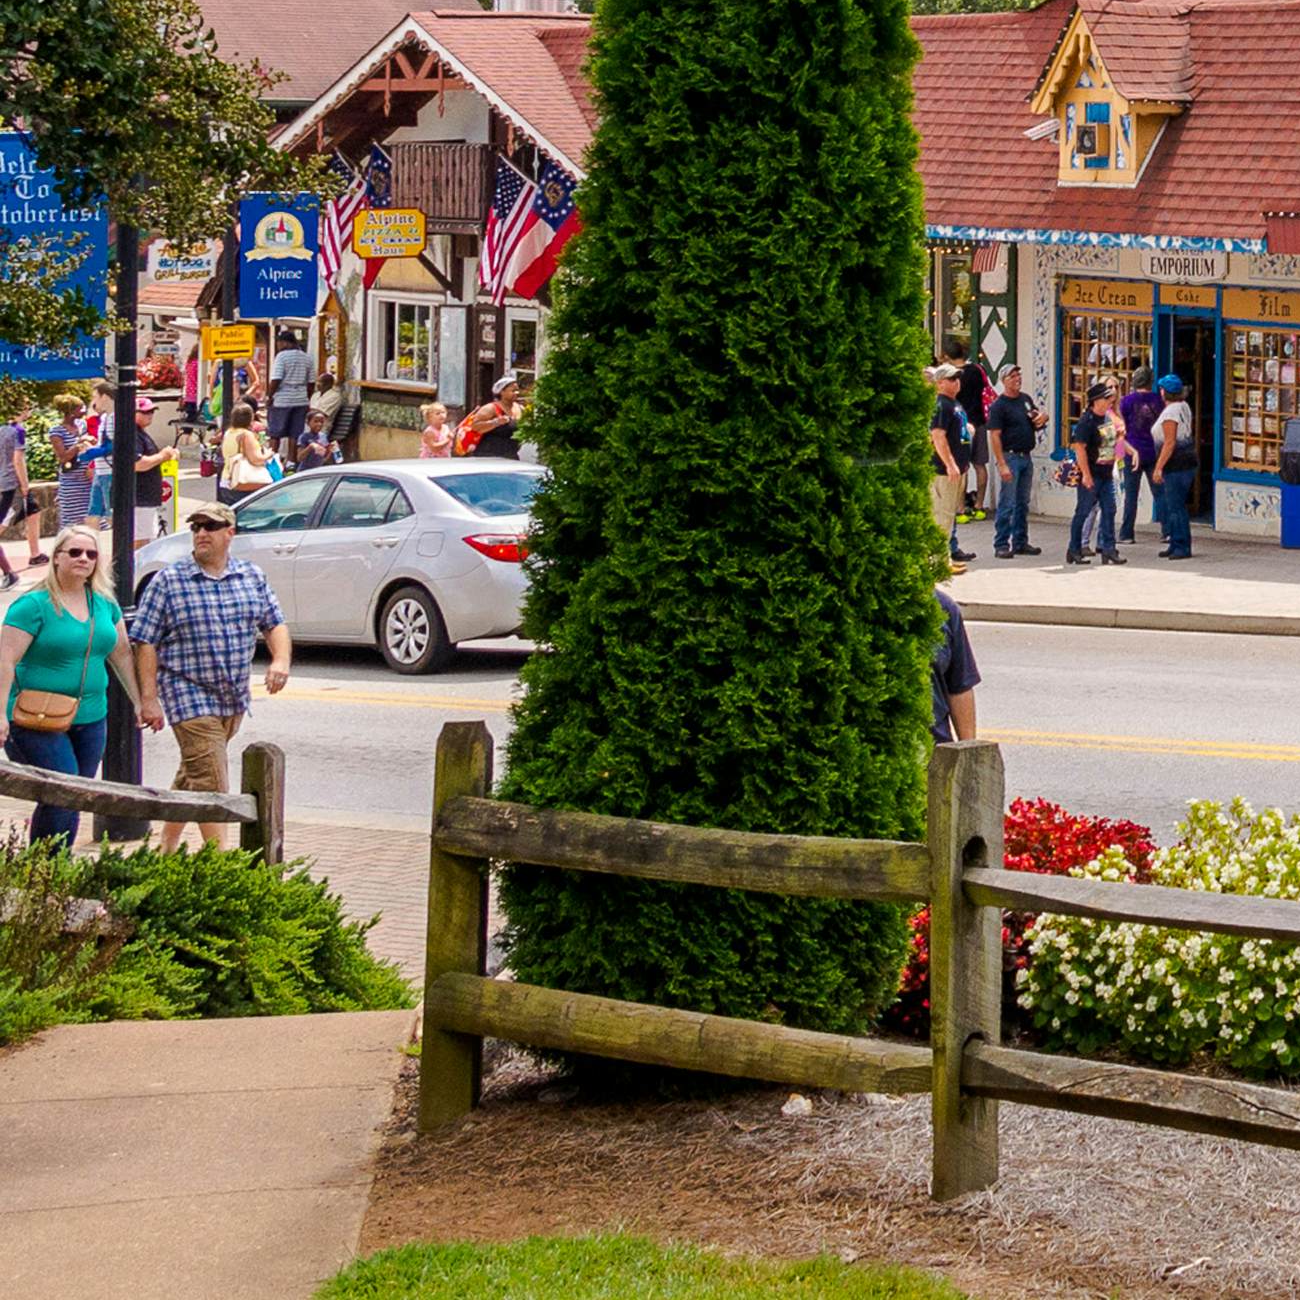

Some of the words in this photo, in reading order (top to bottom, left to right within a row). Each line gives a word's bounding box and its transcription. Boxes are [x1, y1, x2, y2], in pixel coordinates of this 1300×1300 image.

[14, 174, 49, 200] To
[0, 201, 101, 225] toberfest
[366, 211, 416, 226] Alpine
[364, 227, 402, 236] PIZZA
[256, 267, 303, 283] Alpine
[1150, 256, 1214, 277] EMPORIUM
[259, 286, 299, 300] Helen
[1075, 284, 1096, 304] Ice
[1098, 285, 1138, 307] Cream
[1258, 295, 1291, 316] Film
